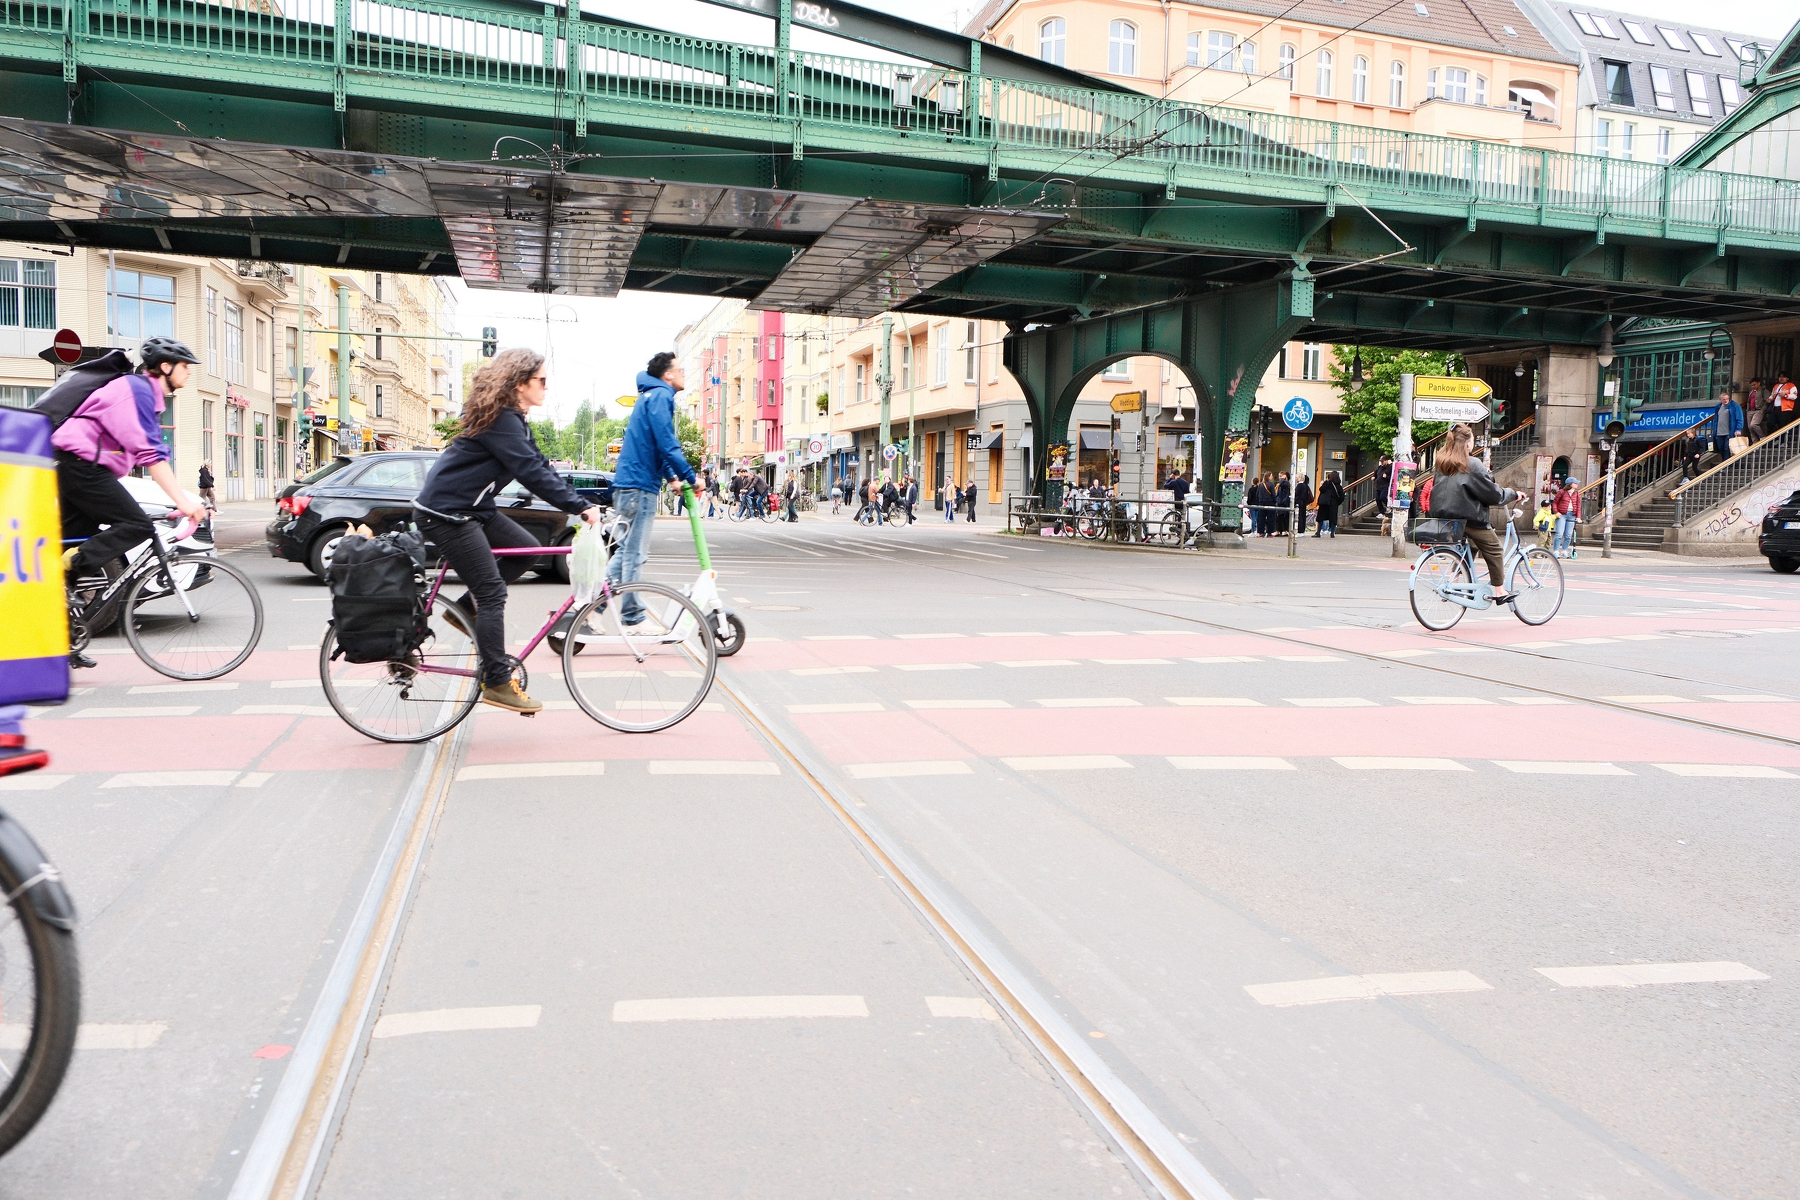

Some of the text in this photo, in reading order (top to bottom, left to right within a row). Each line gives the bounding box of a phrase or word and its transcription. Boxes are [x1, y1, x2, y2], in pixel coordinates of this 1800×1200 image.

[1428, 382, 1456, 392] Pankow
[1420, 406, 1478, 416] Max-Schmeling-Halle
[314, 417, 326, 425] sky
[1634, 412, 1696, 426] Eberswalder
[812, 443, 820, 451] 30
[0, 517, 48, 584] ir
